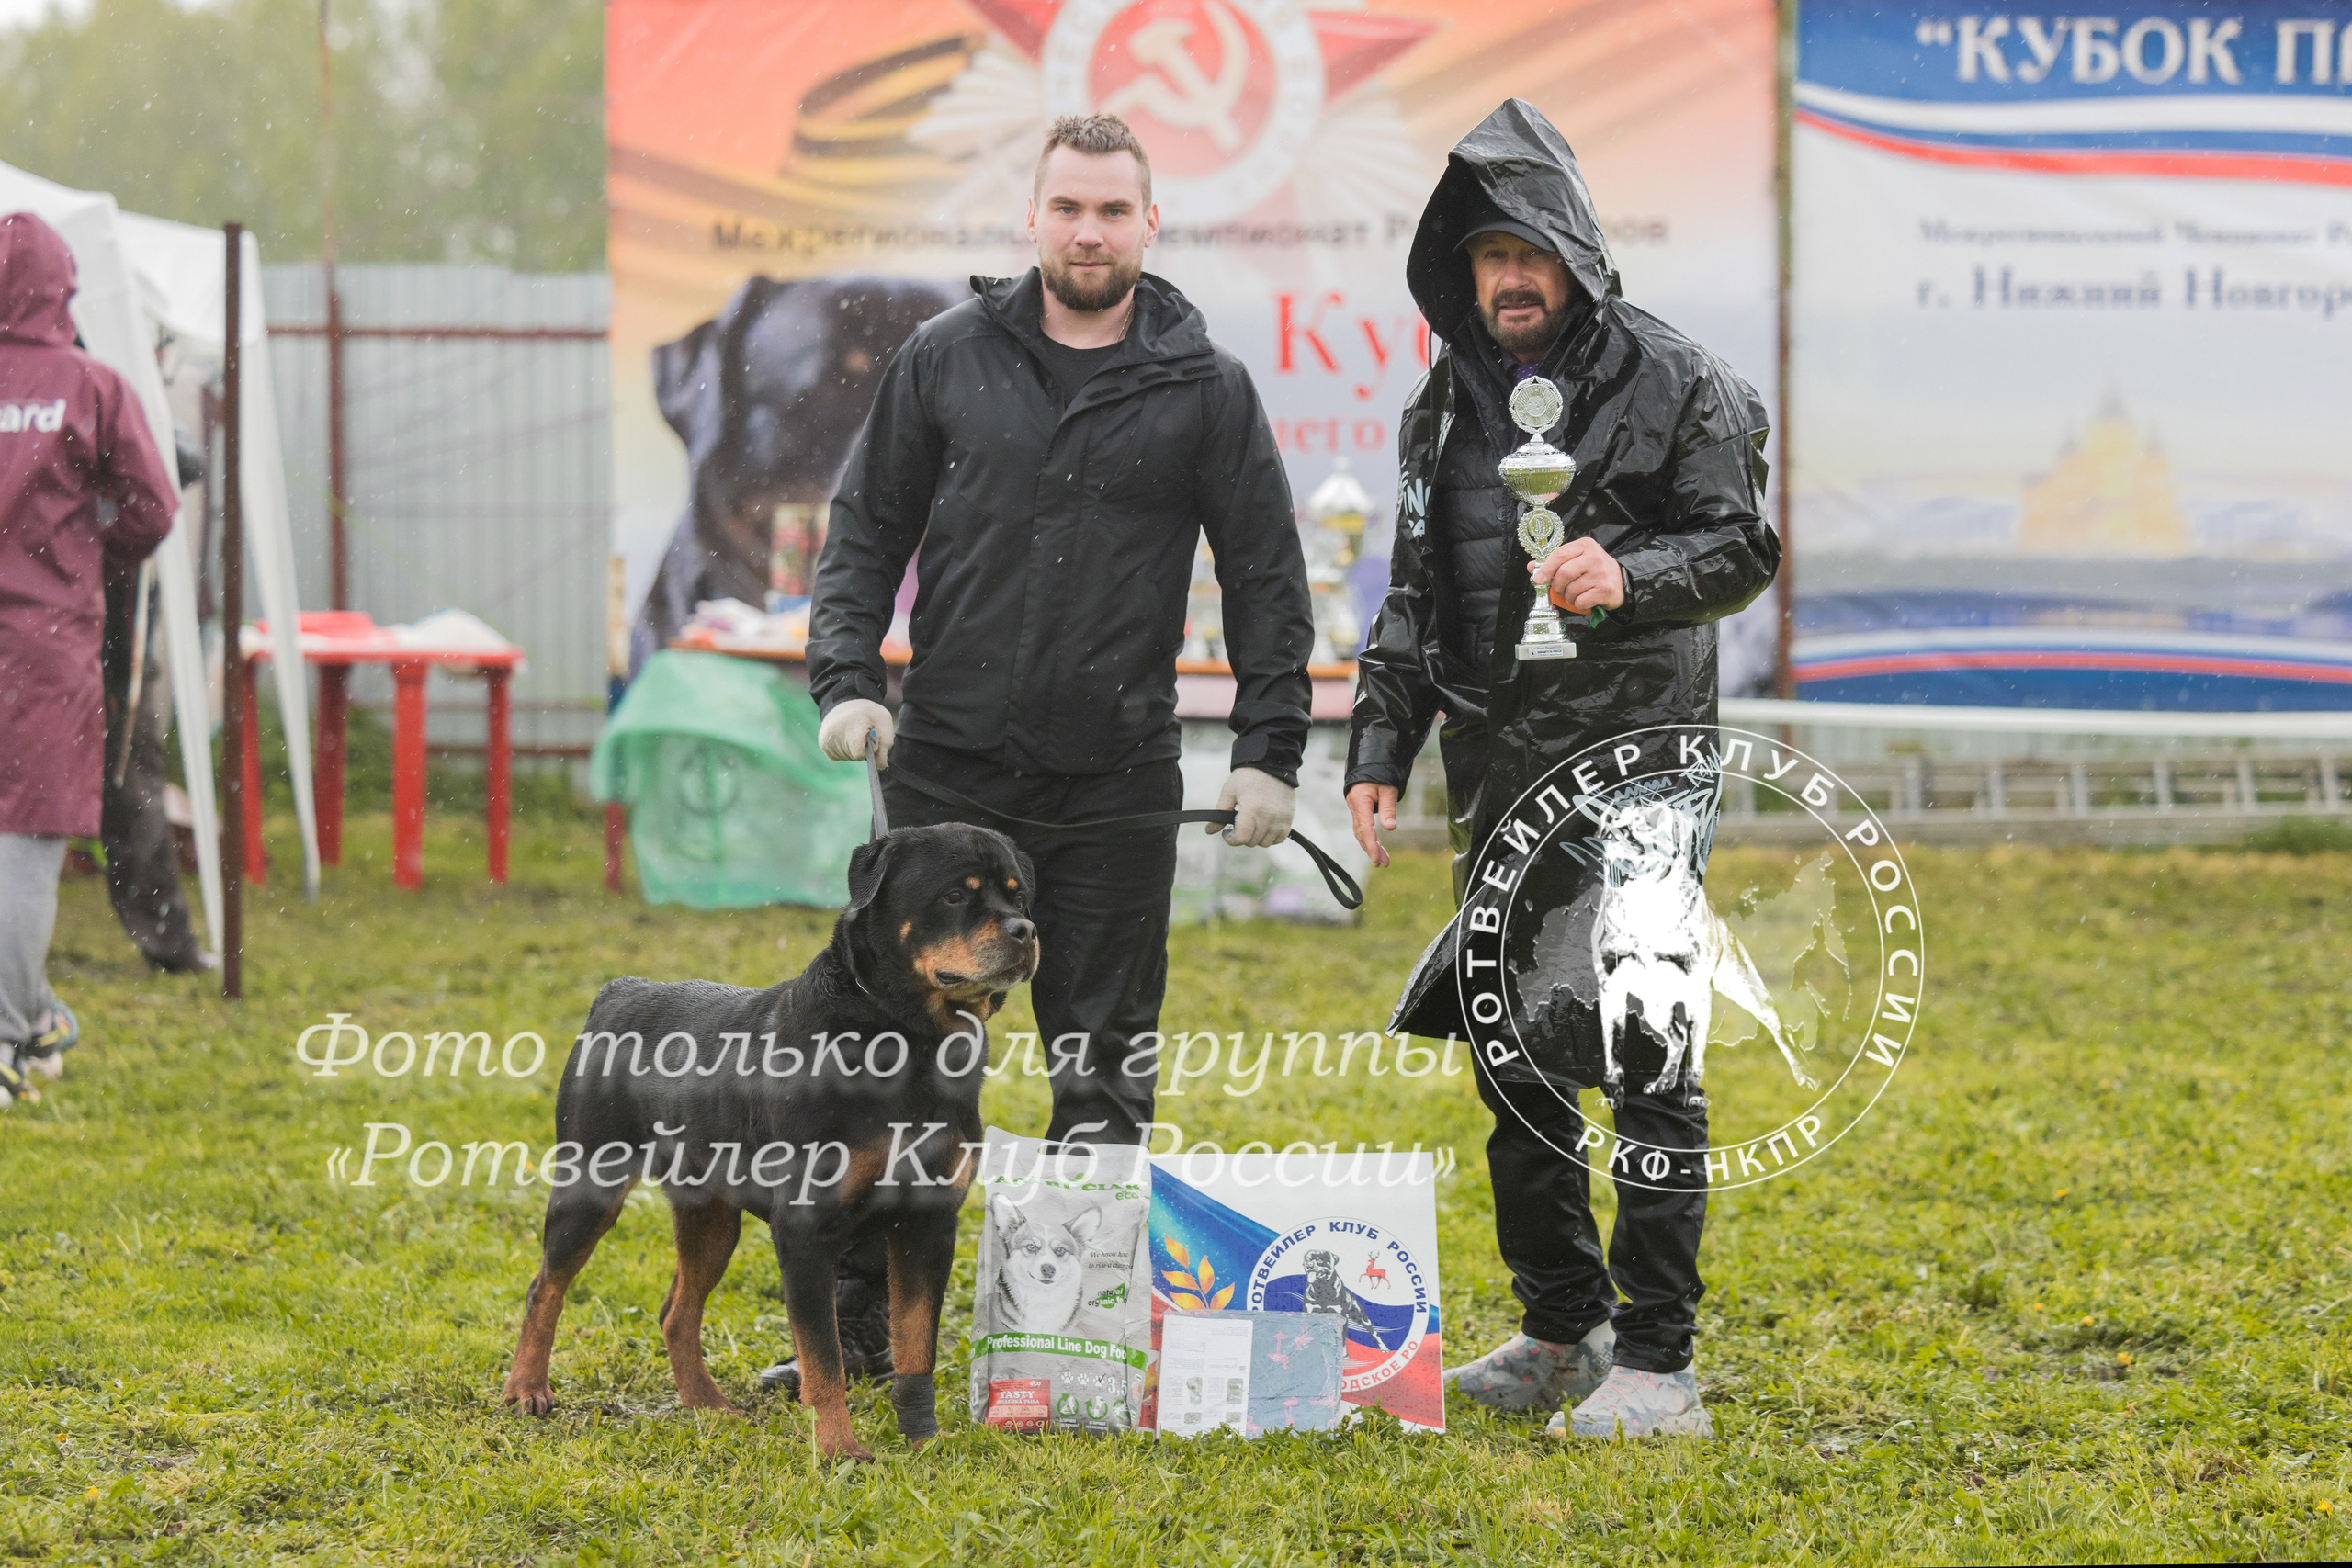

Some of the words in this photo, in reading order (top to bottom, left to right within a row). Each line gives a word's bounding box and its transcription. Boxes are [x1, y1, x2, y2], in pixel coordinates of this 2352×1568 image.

[1329, 1221, 1379, 1240] КЛУБ
[1386, 1240, 1427, 1313] РОССИИ
[1088, 1296, 1114, 1306] organic
[1098, 1288, 1123, 1296] natural
[988, 1335, 1055, 1349] Professional
[1057, 1337, 1082, 1352] Line
[1085, 1341, 1107, 1359] Dog
[1110, 1343, 1126, 1359] Foo
[1341, 1360, 1401, 1391] ОДСКОЕ
[1401, 1340, 1418, 1359] РО
[999, 1390, 1035, 1399] TASTY
[1107, 1376, 1127, 1396] 3,5
